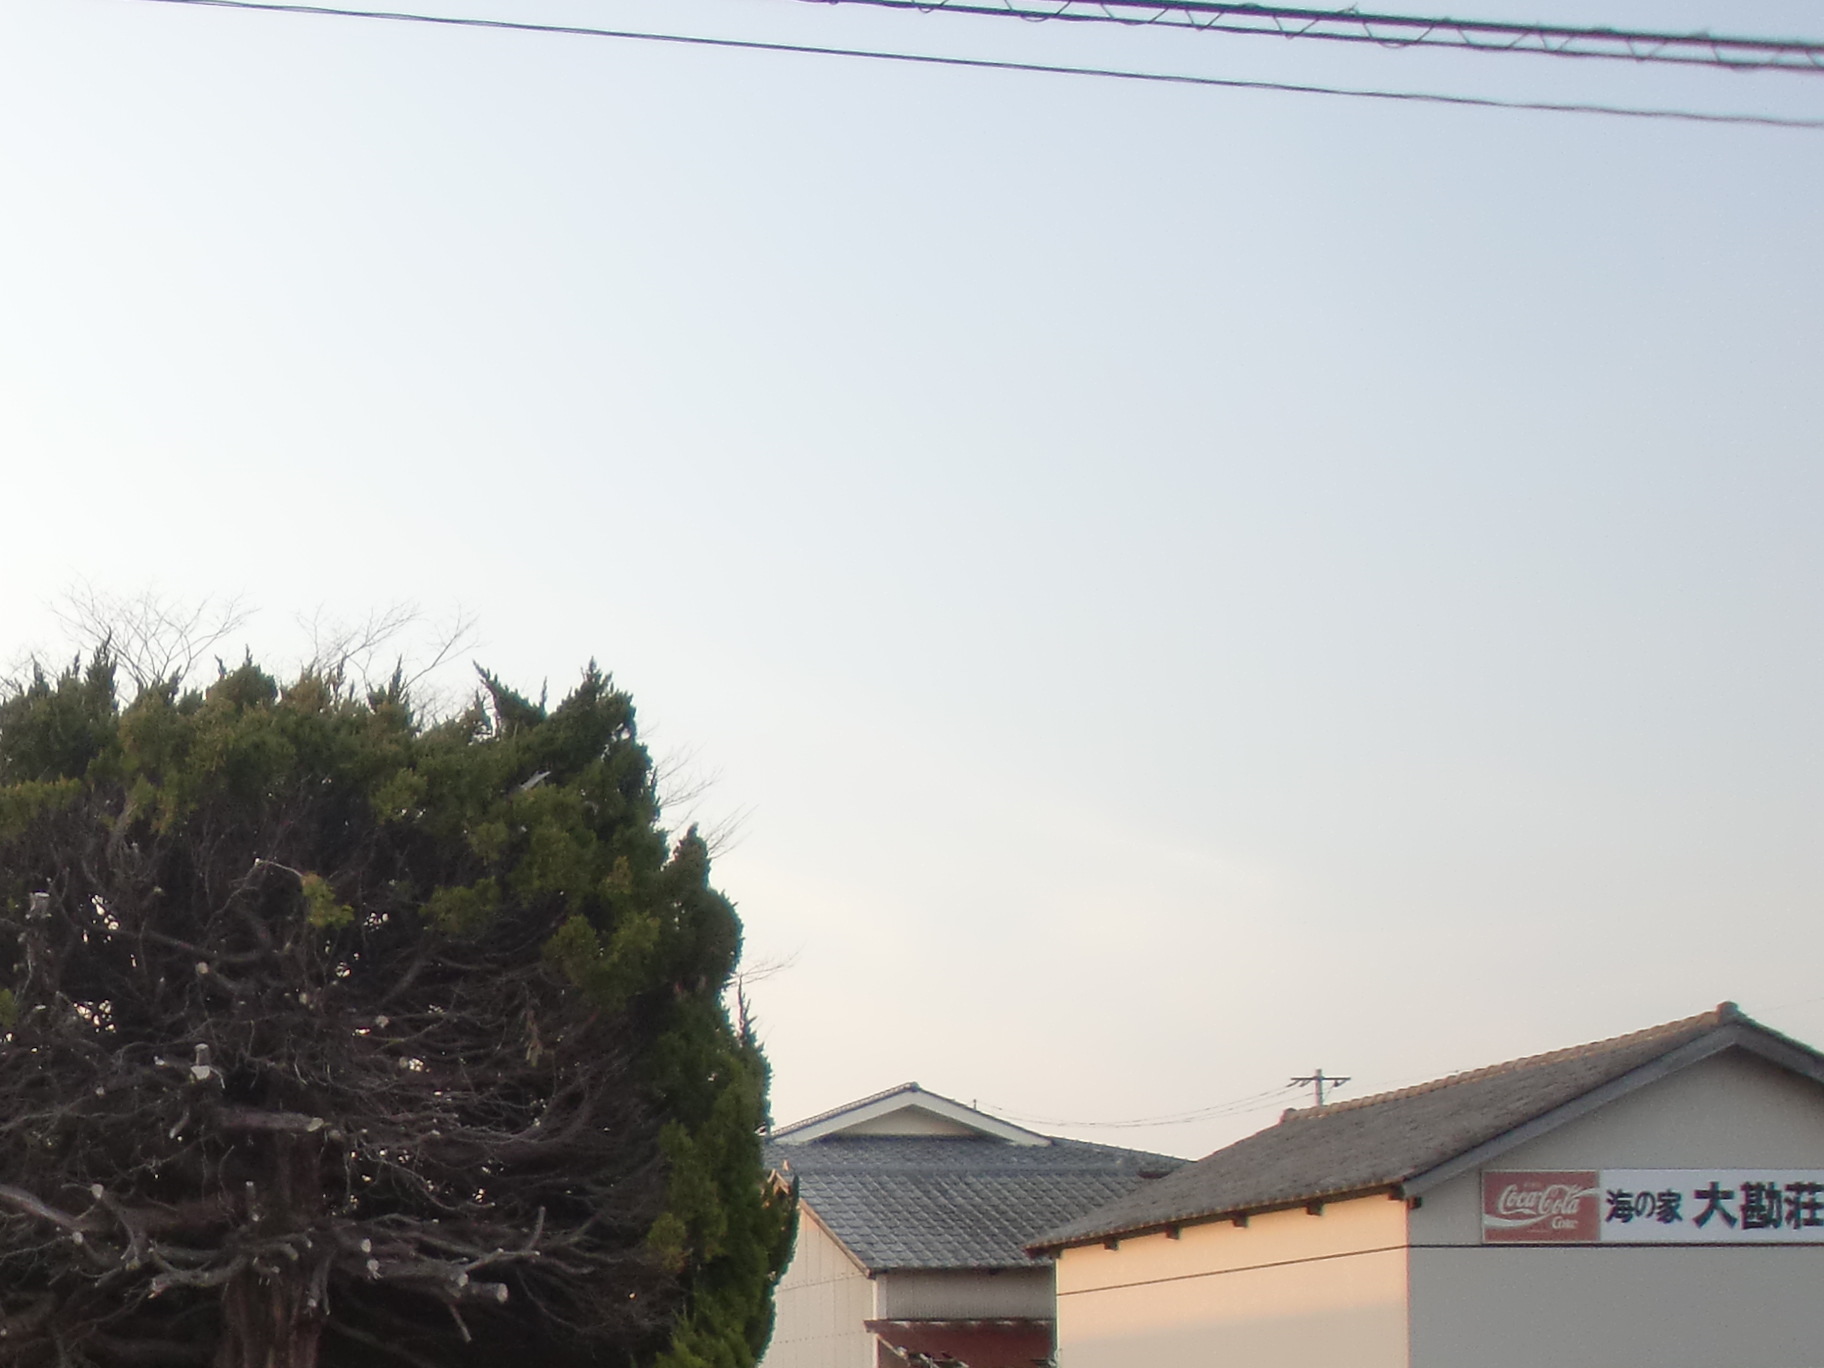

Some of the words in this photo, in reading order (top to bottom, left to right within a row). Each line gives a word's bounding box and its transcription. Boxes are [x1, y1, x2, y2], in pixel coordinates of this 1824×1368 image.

[1498, 1184, 1581, 1215] Coca-Cola
[1606, 1189, 1683, 1223] 海の家
